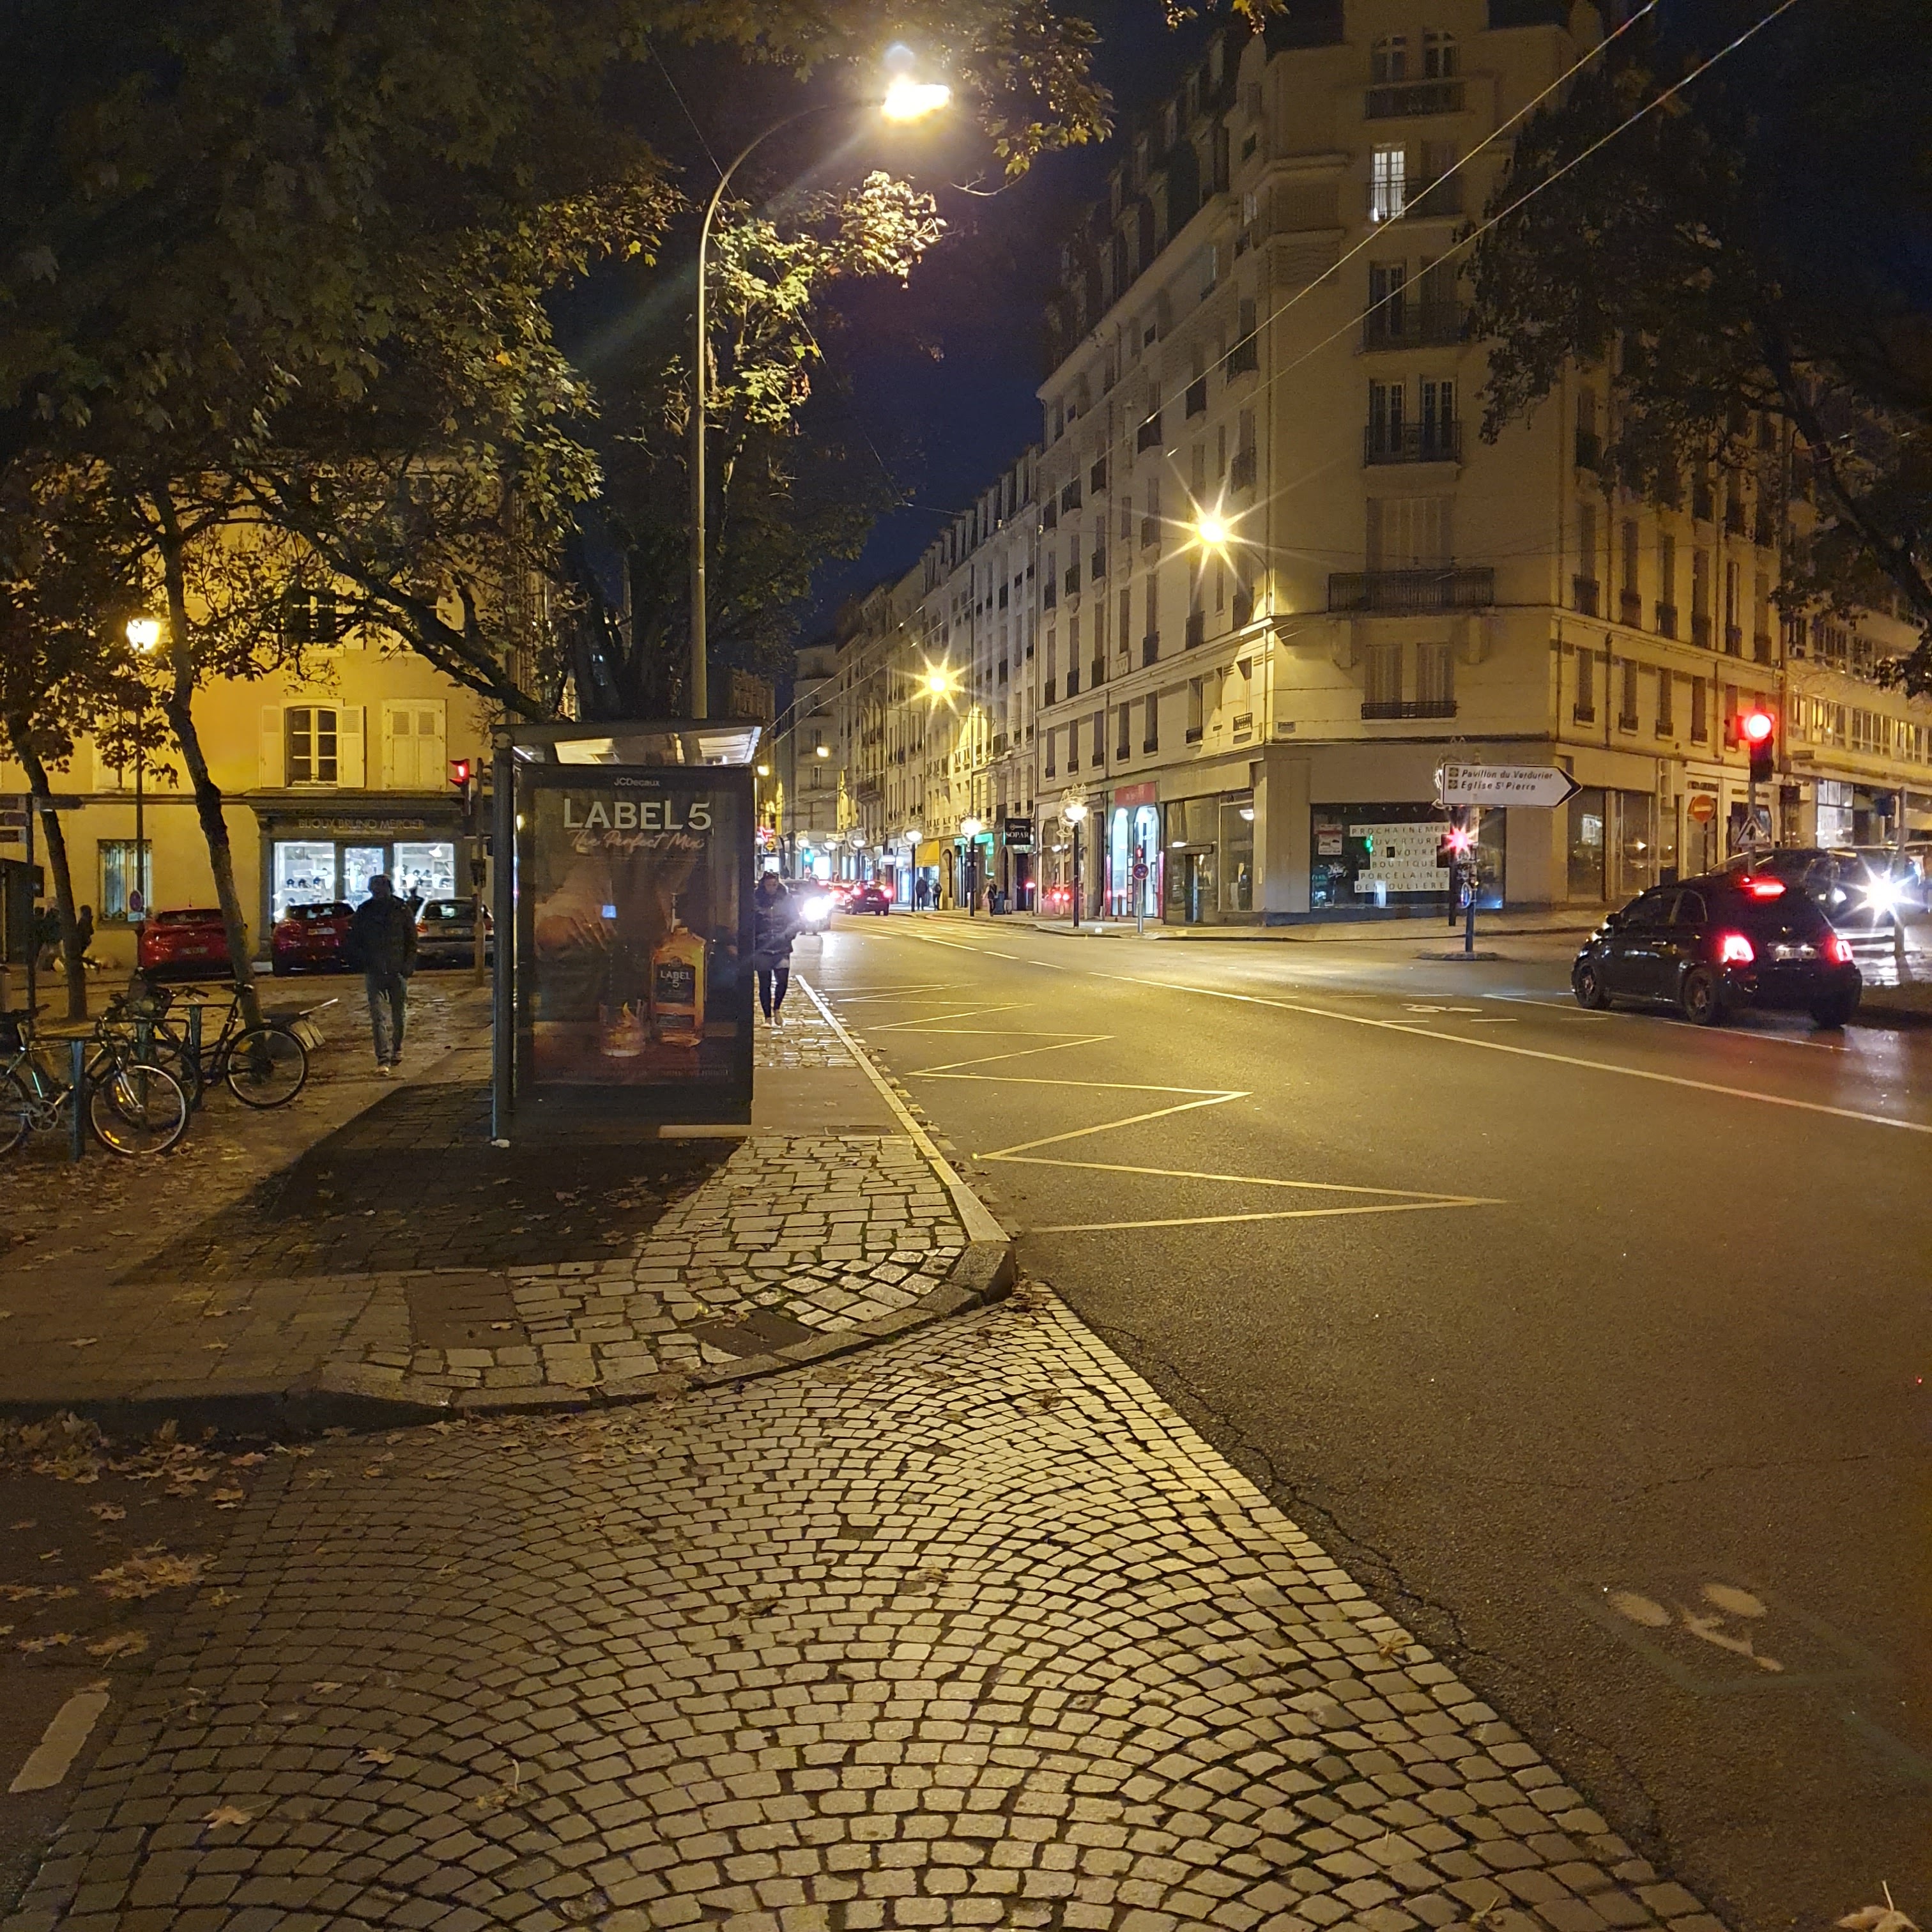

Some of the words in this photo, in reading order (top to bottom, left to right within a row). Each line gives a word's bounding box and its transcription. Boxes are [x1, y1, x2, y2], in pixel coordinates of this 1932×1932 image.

[1462, 769, 1496, 778] Pavillon
[1501, 770, 1510, 778] du
[1514, 770, 1553, 779] Verdurier
[613, 778, 661, 787] JCDecaux
[1506, 783, 1536, 791] Pierre
[564, 799, 684, 830] LABEL
[687, 802, 712, 830] 5
[298, 818, 335, 829] BIJOUX
[338, 818, 377, 829] BRUNO
[567, 829, 601, 847] The
[602, 830, 669, 854] Perfect
[666, 832, 705, 850] Mix
[1397, 848, 1435, 857] VOTRE
[1361, 871, 1448, 880] PORCELAINES
[660, 970, 691, 980] LABEL
[672, 979, 680, 988] 5
